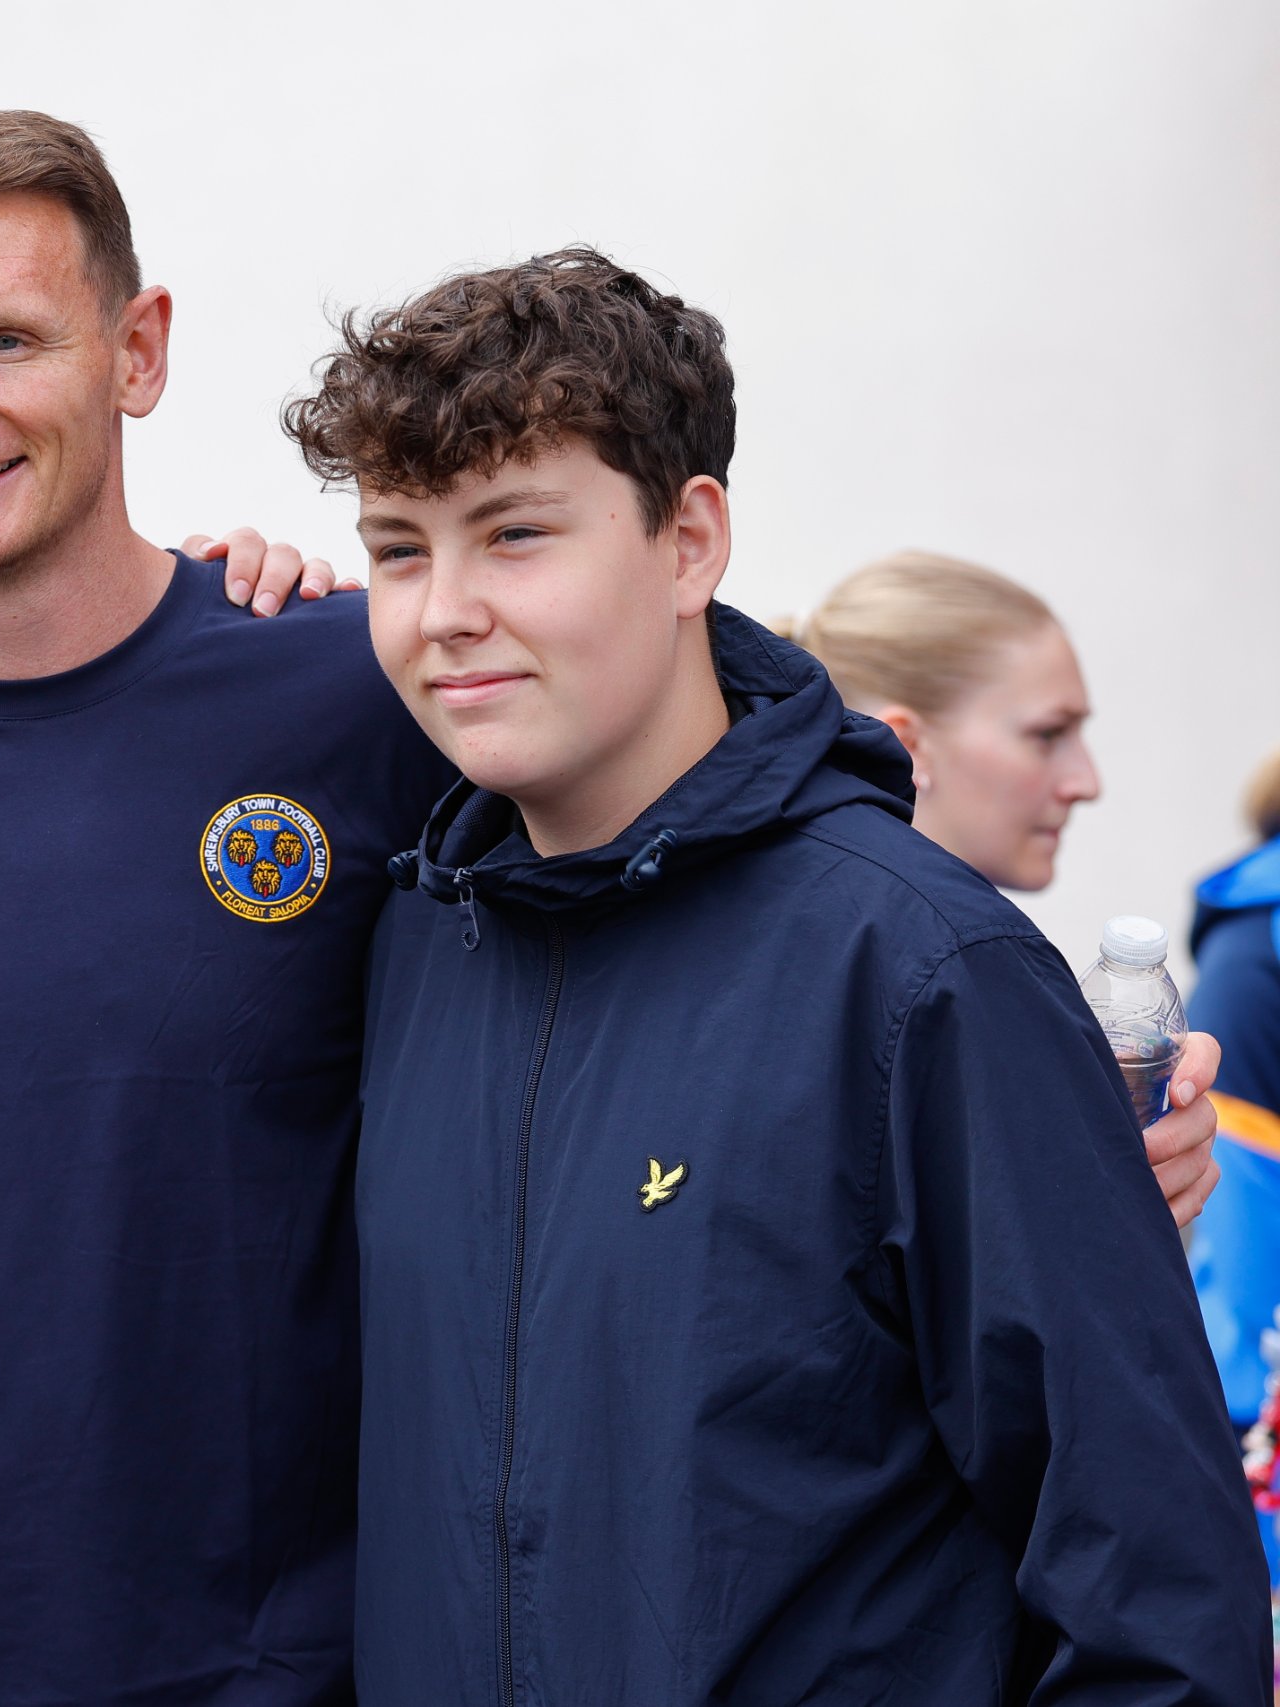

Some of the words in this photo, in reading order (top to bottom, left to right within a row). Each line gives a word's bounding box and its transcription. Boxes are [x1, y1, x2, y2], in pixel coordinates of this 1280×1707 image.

[205, 804, 241, 872] SHREWSBURY
[242, 799, 275, 811] TOWN
[278, 801, 322, 847] FOOTBALL
[313, 848, 326, 878] CLUB
[250, 819, 280, 831] 1886
[221, 890, 266, 917] FLOREAT
[269, 894, 311, 918] SALOPIA
